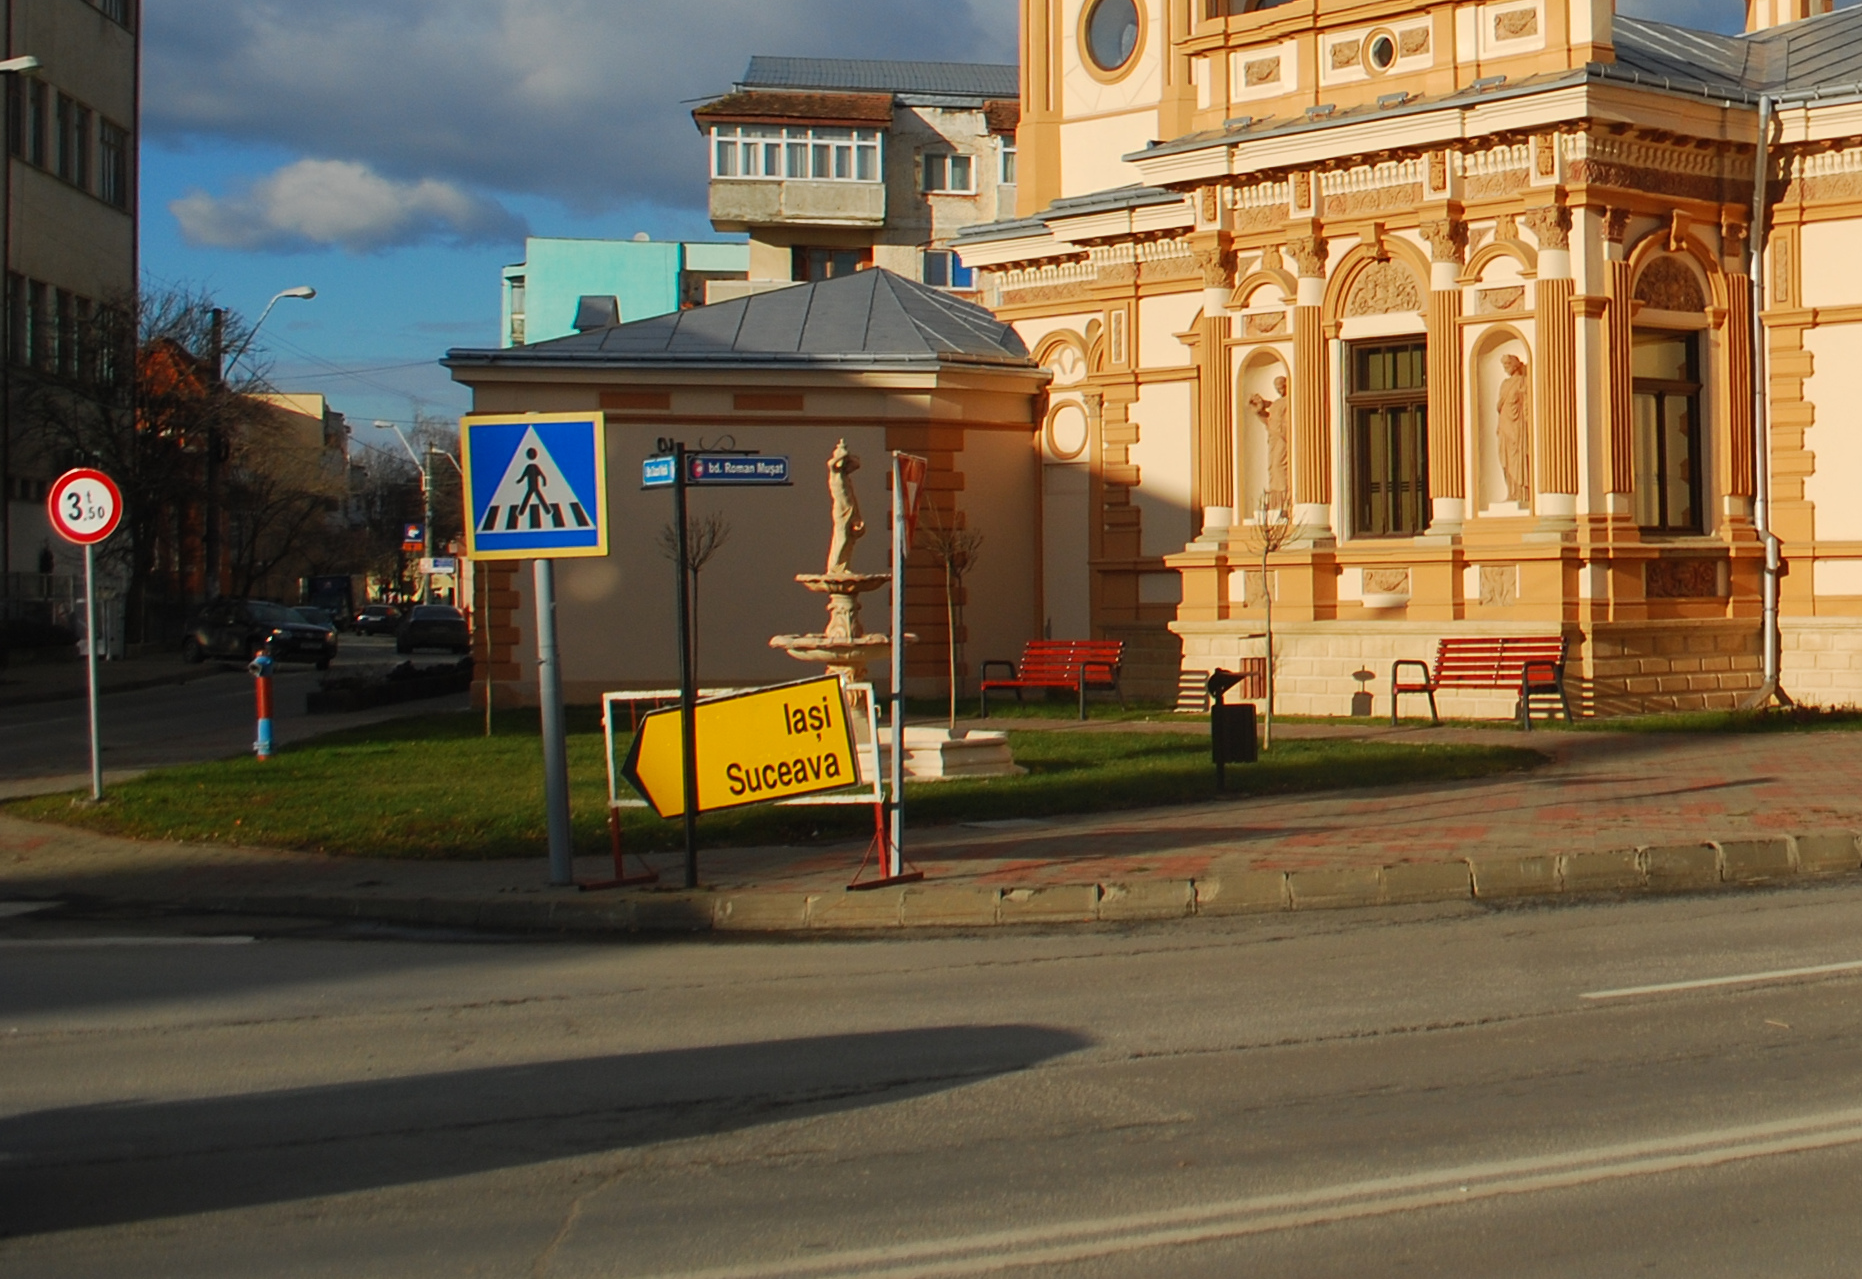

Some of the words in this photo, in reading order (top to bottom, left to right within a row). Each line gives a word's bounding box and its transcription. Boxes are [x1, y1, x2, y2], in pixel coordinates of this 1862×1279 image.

[724, 462, 755, 474] Roman
[783, 695, 832, 743] Iași
[726, 752, 841, 797] Suceava
